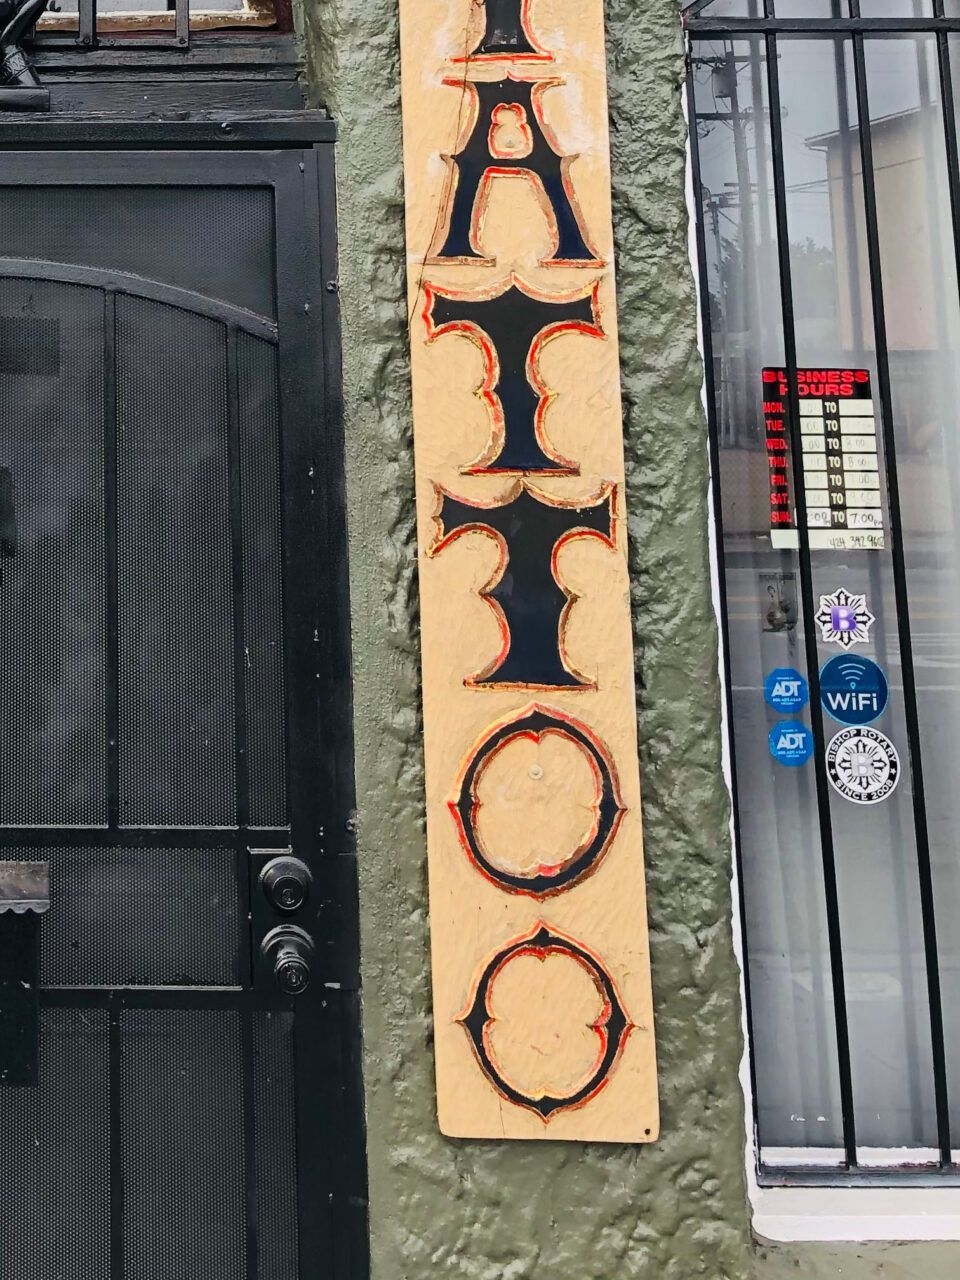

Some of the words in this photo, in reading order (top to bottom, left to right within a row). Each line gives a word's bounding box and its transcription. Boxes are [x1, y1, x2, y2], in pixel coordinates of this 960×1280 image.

[824, 401, 837, 413] TO
[826, 420, 838, 431] TO
[827, 438, 839, 450] TO
[828, 456, 841, 468] TO
[830, 474, 842, 486] TO
[831, 492, 844, 504] TO
[832, 511, 845, 523] TO
[771, 681, 802, 697] ADT
[827, 692, 878, 711] WiFi
[777, 733, 807, 750] ADT
[828, 729, 857, 762] BISHOP
[860, 729, 897, 762] ROTARY
[835, 780, 868, 801] SINCE
